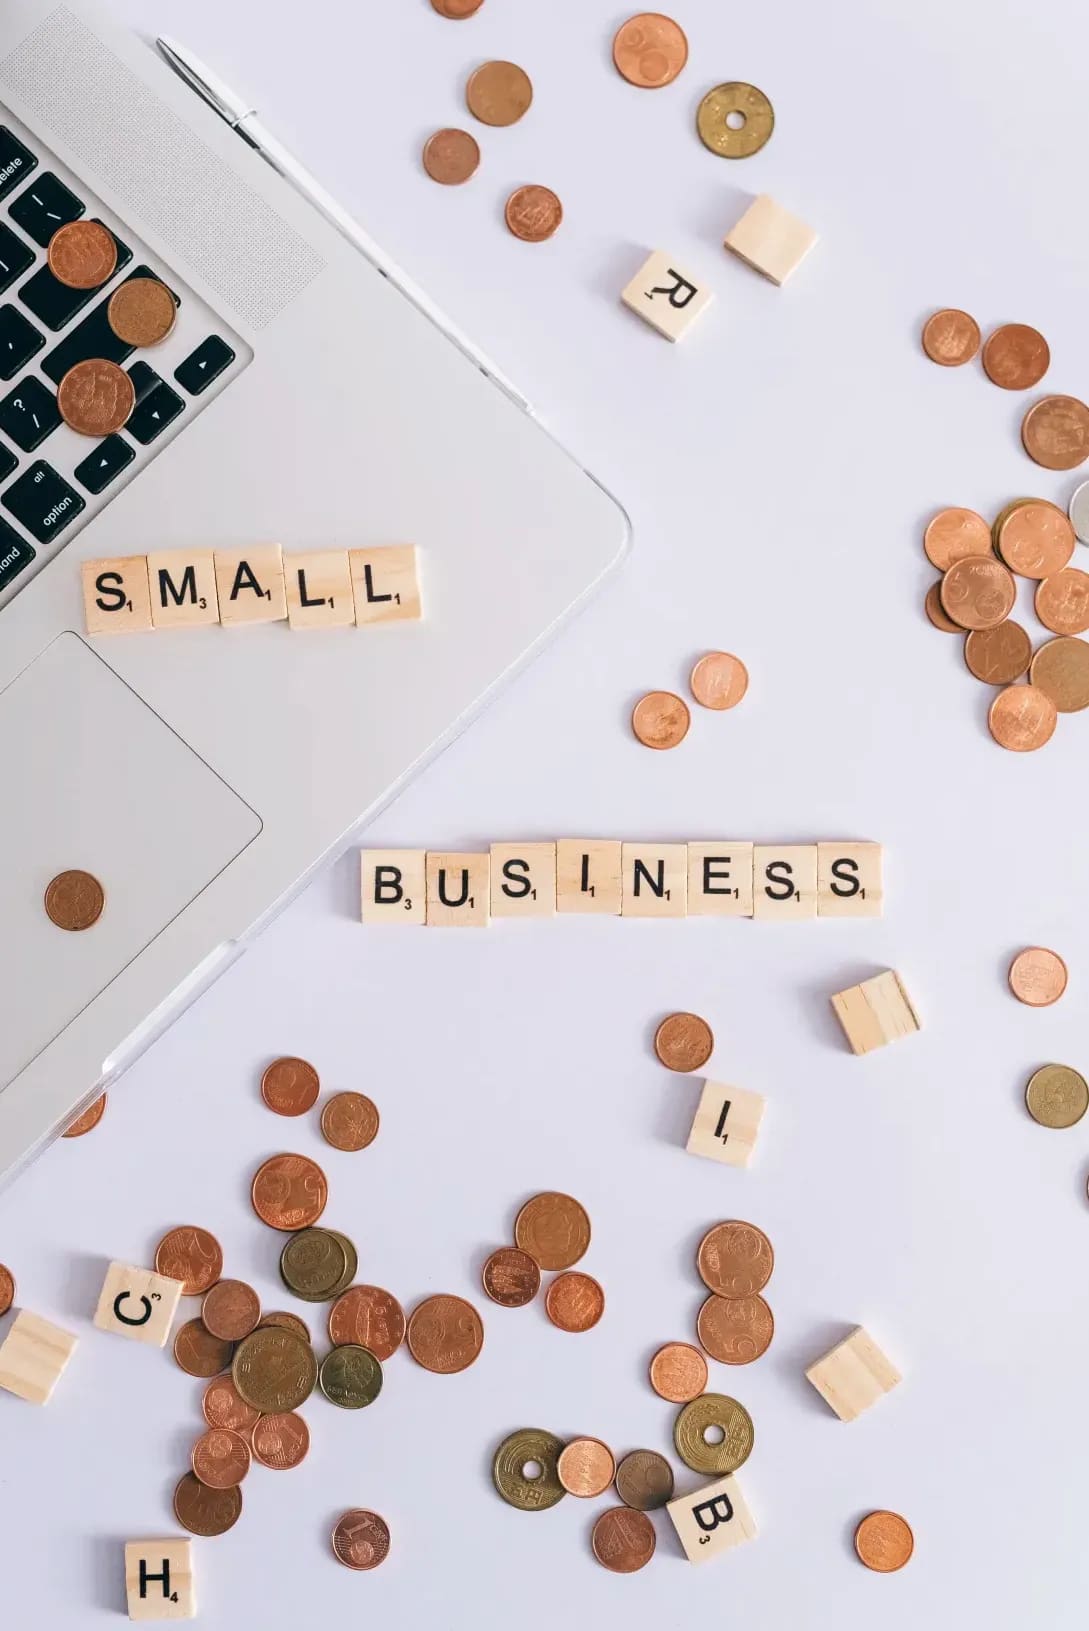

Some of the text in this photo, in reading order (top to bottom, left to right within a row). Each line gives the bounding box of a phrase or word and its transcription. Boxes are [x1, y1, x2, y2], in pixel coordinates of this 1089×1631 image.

[0, 157, 23, 185] elete
[651, 268, 698, 309] R
[33, 470, 45, 483] alt
[43, 497, 73, 527] option
[374, 854, 860, 908] BUSINESS
[113, 1290, 153, 1327] C
[691, 1492, 734, 1532] B
[138, 1558, 170, 1599] H
